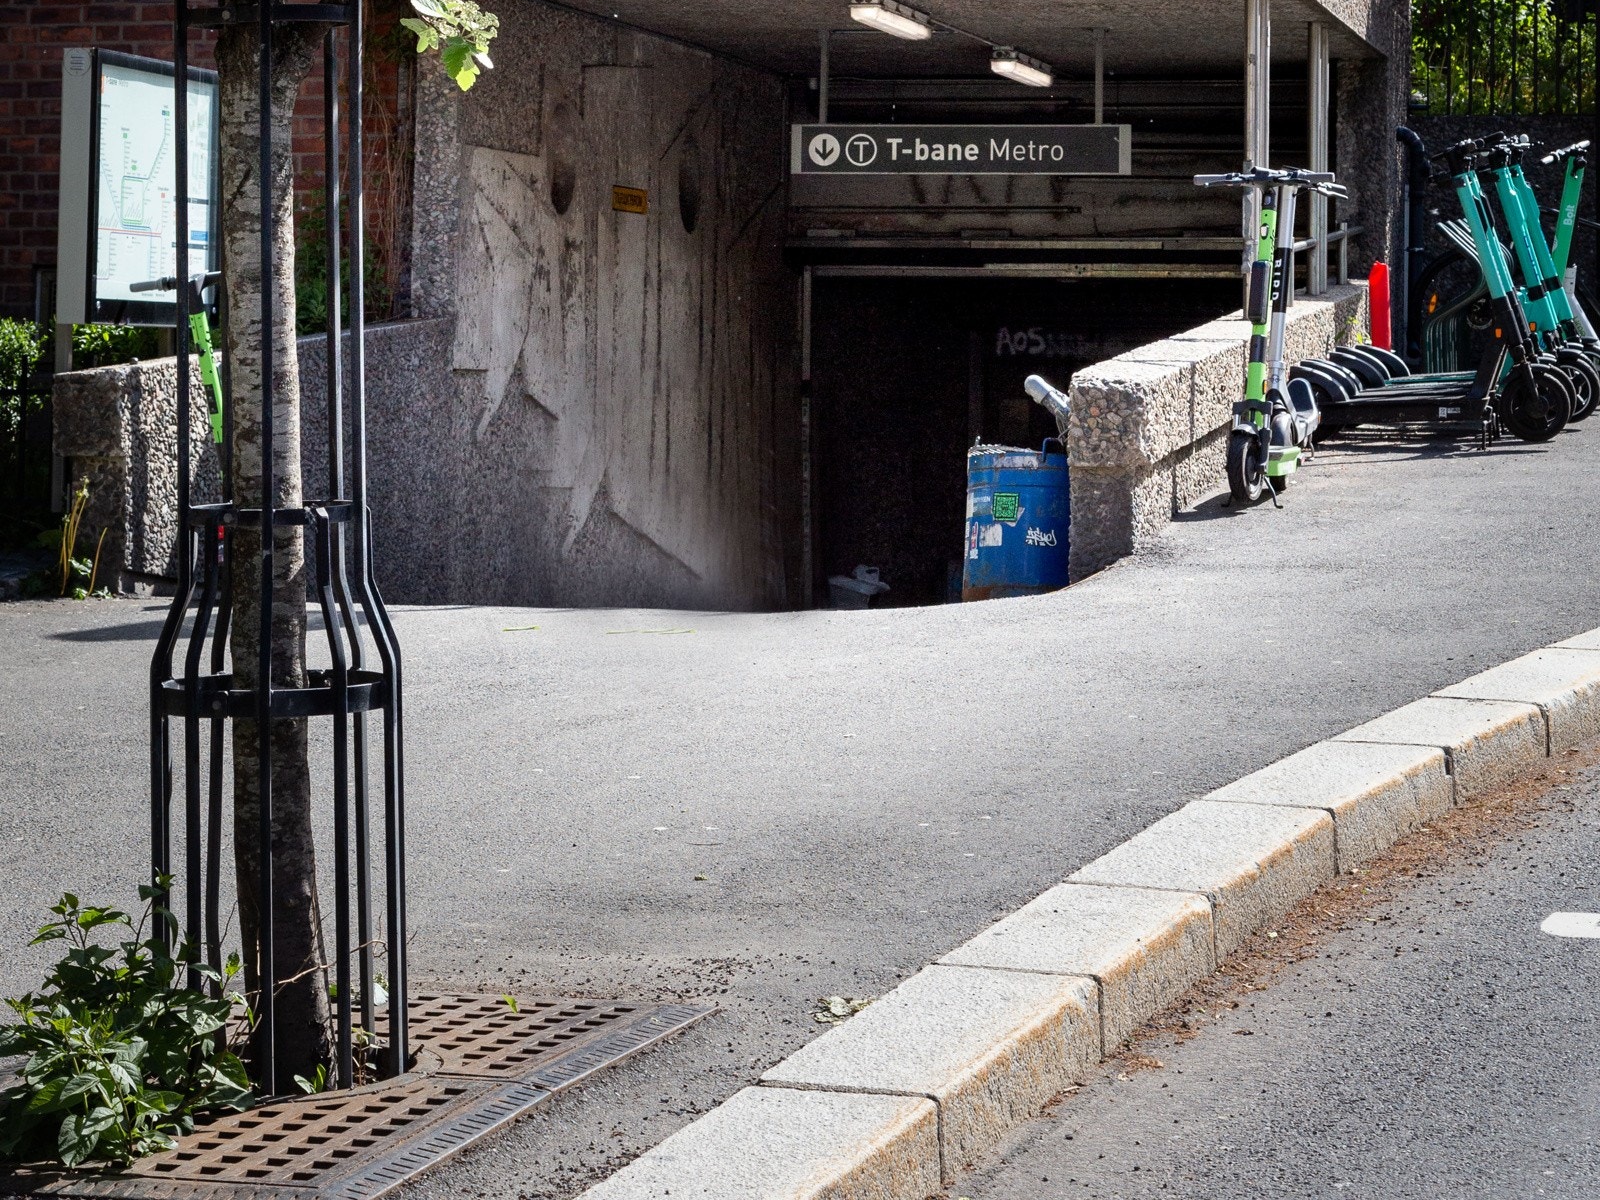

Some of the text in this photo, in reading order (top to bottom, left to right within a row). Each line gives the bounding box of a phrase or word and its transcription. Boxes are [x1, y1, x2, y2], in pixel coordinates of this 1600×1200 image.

[887, 138, 979, 161] T-bane
[989, 138, 1064, 161] Metro
[1563, 204, 1575, 225] Bolt
